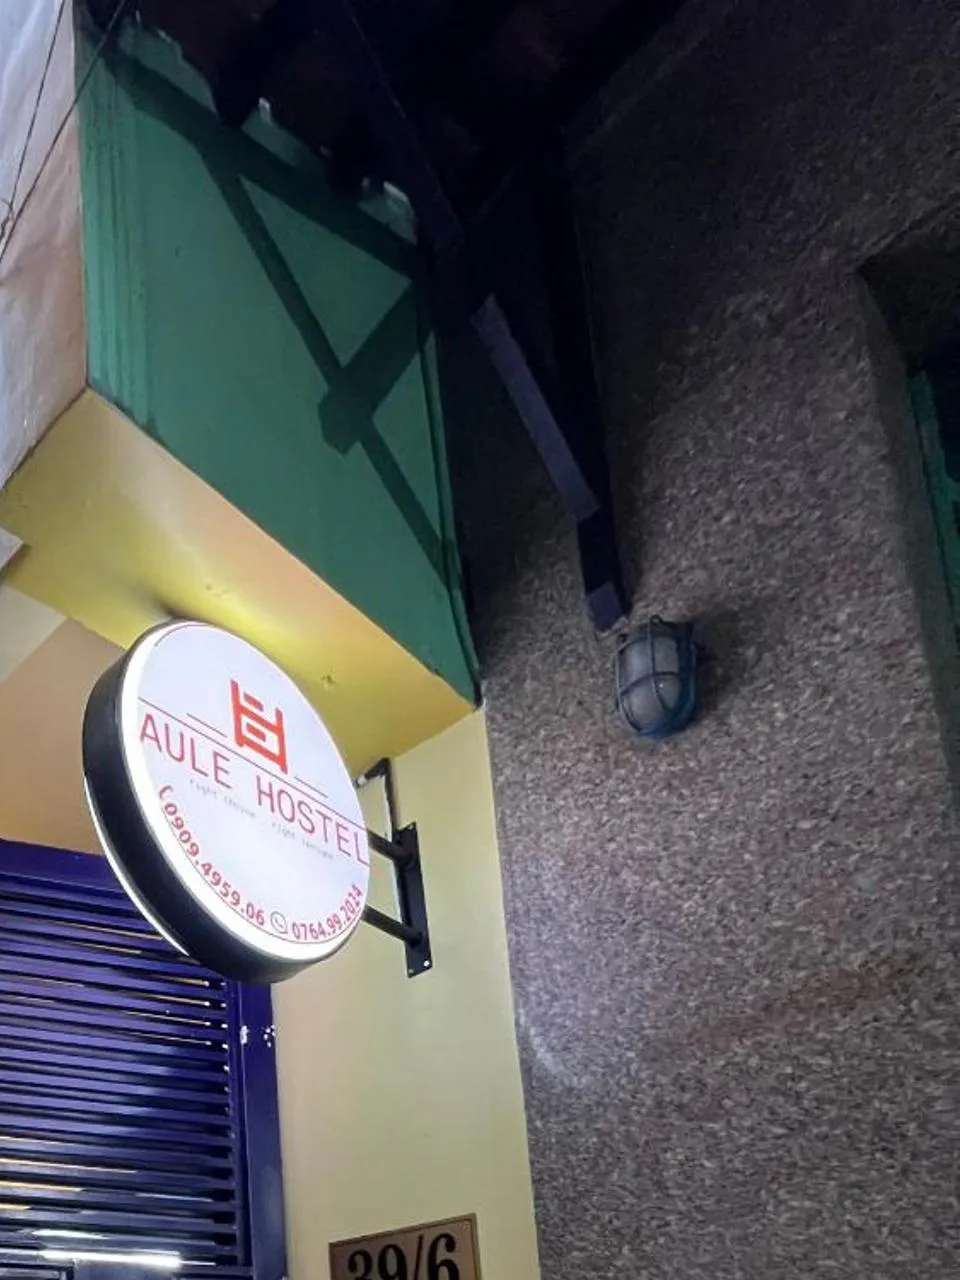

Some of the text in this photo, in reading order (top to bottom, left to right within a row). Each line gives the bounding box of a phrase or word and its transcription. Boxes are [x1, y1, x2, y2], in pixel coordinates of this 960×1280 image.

[140, 712, 232, 790] AULE
[256, 774, 370, 868] HOSTEL
[164, 802, 266, 927] 0909.4959.06
